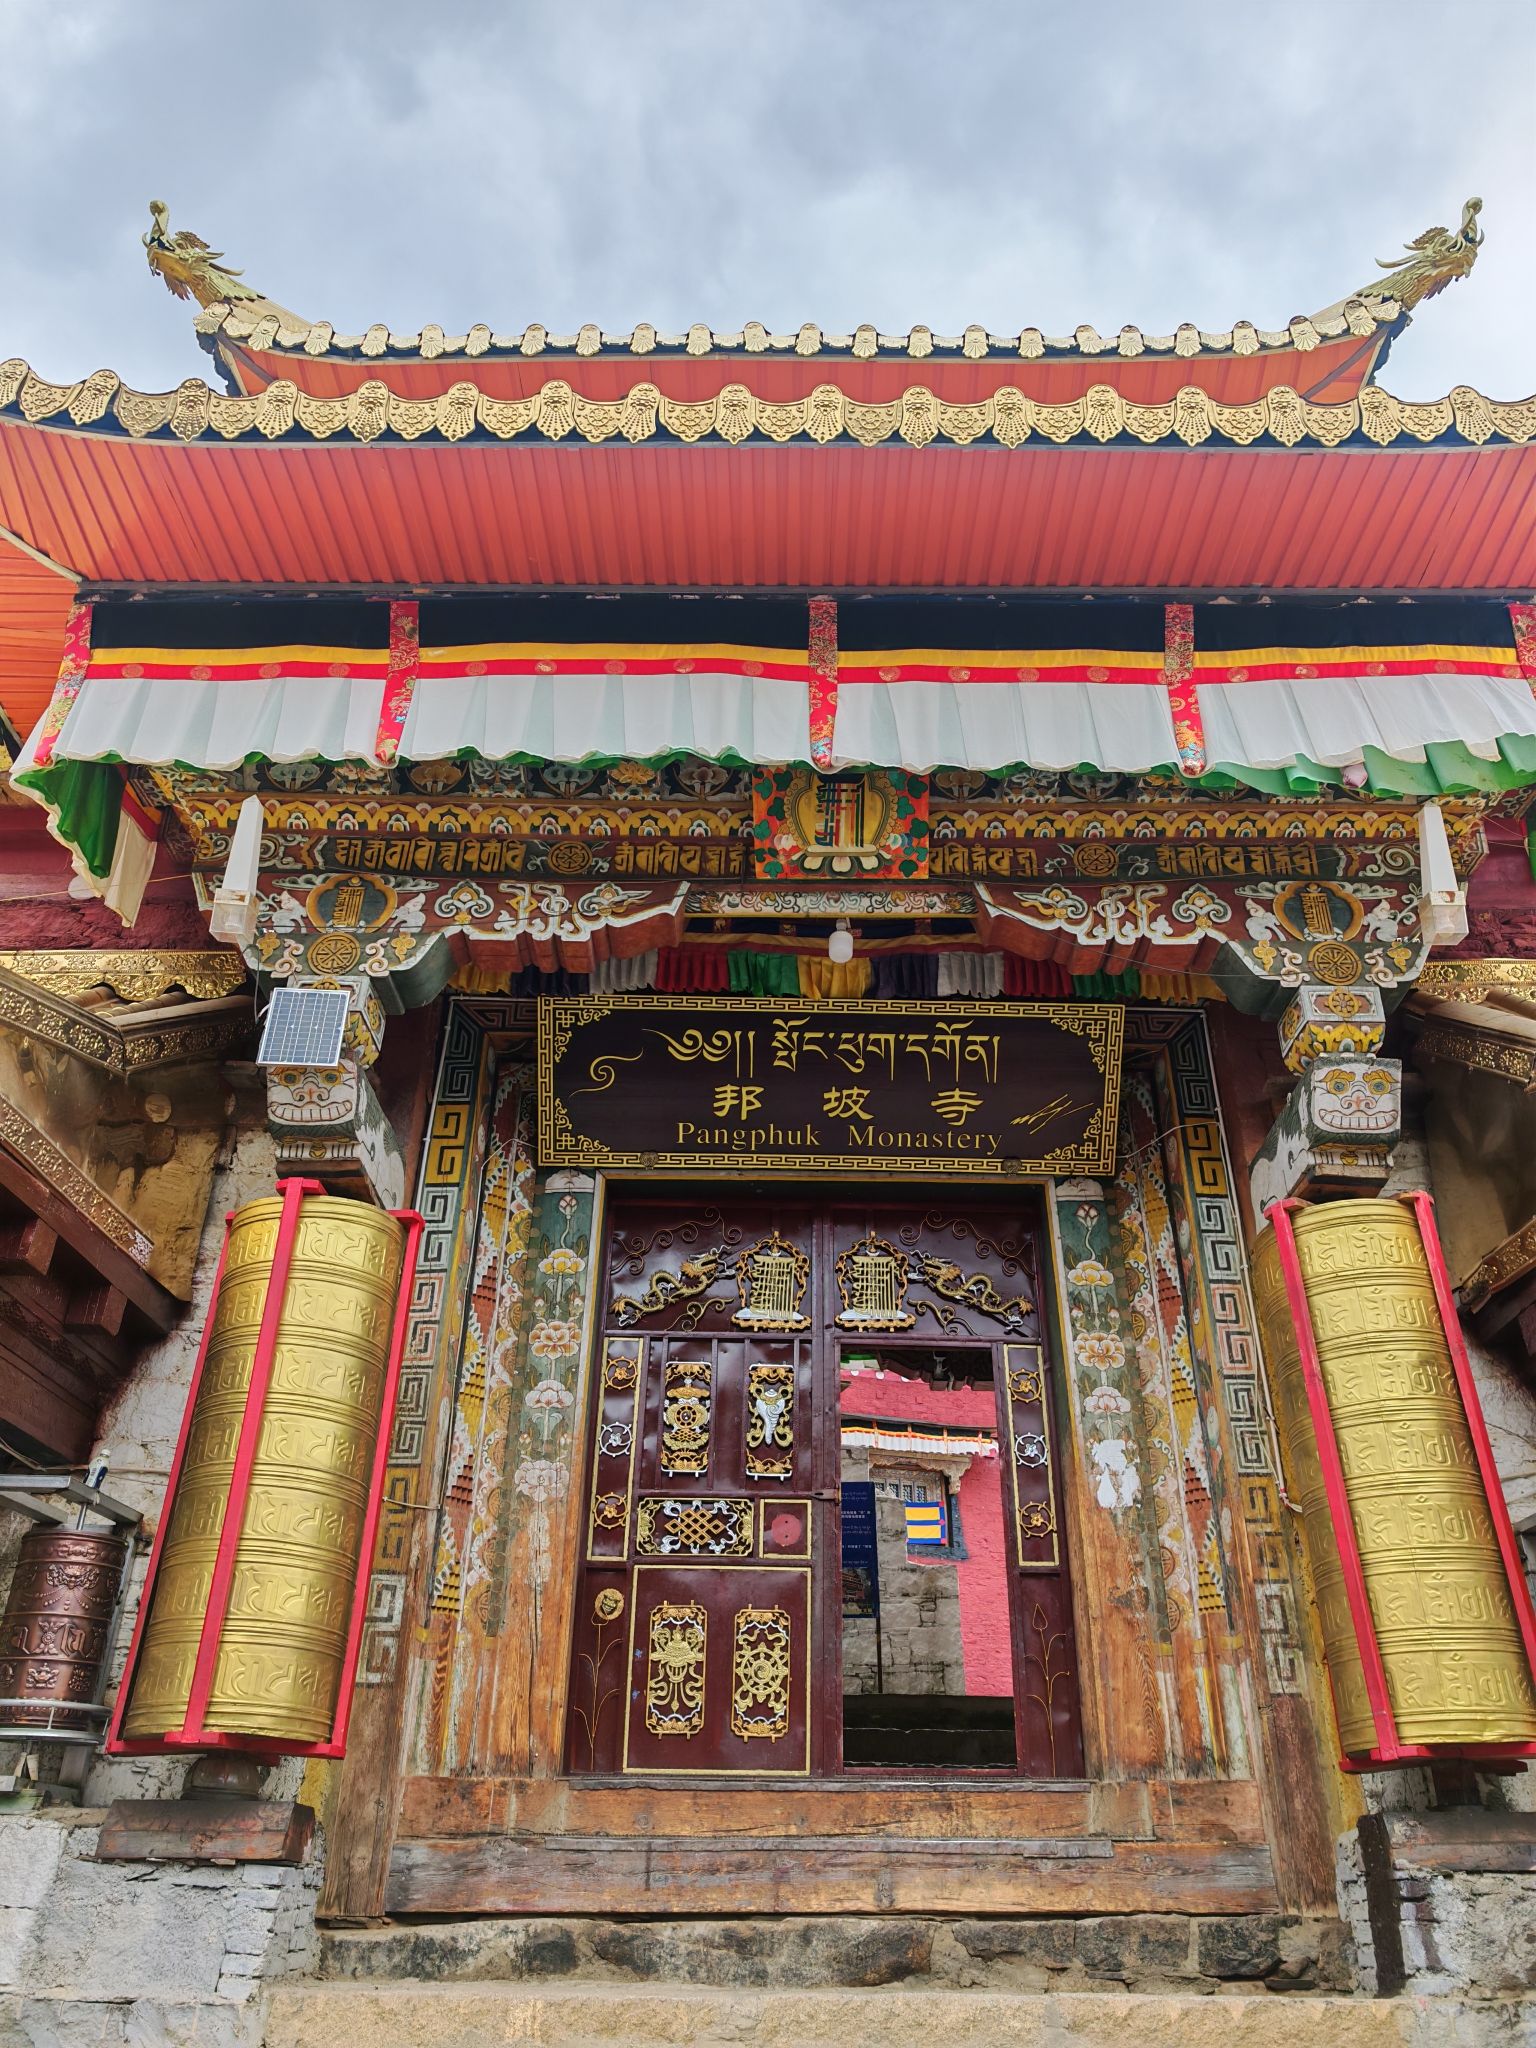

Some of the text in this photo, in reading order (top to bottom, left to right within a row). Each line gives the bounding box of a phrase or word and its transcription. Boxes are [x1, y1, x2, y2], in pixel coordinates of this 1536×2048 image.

[712, 1083, 984, 1126] 邦坡寺
[675, 1121, 1003, 1156] Pangphuk Monastery
